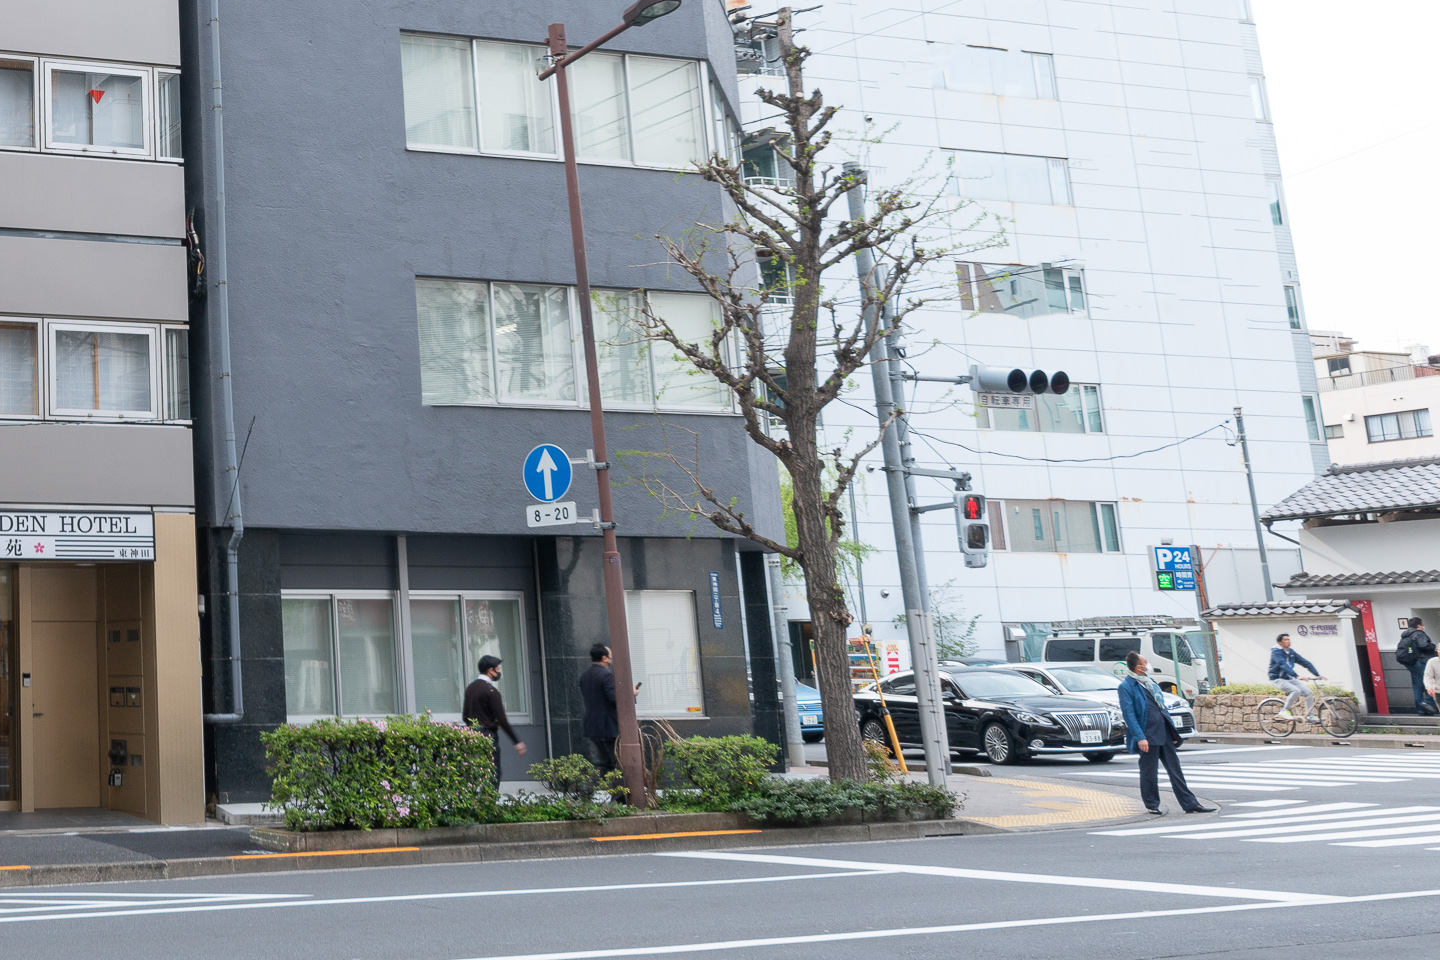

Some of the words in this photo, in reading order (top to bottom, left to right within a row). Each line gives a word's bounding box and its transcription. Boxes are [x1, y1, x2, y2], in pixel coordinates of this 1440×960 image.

[981, 395, 1031, 407] 自転車専用
[59, 515, 137, 534] HOTEL
[1156, 548, 1173, 570] P
[1173, 550, 1191, 563] 24
[1157, 573, 1173, 588] 空
